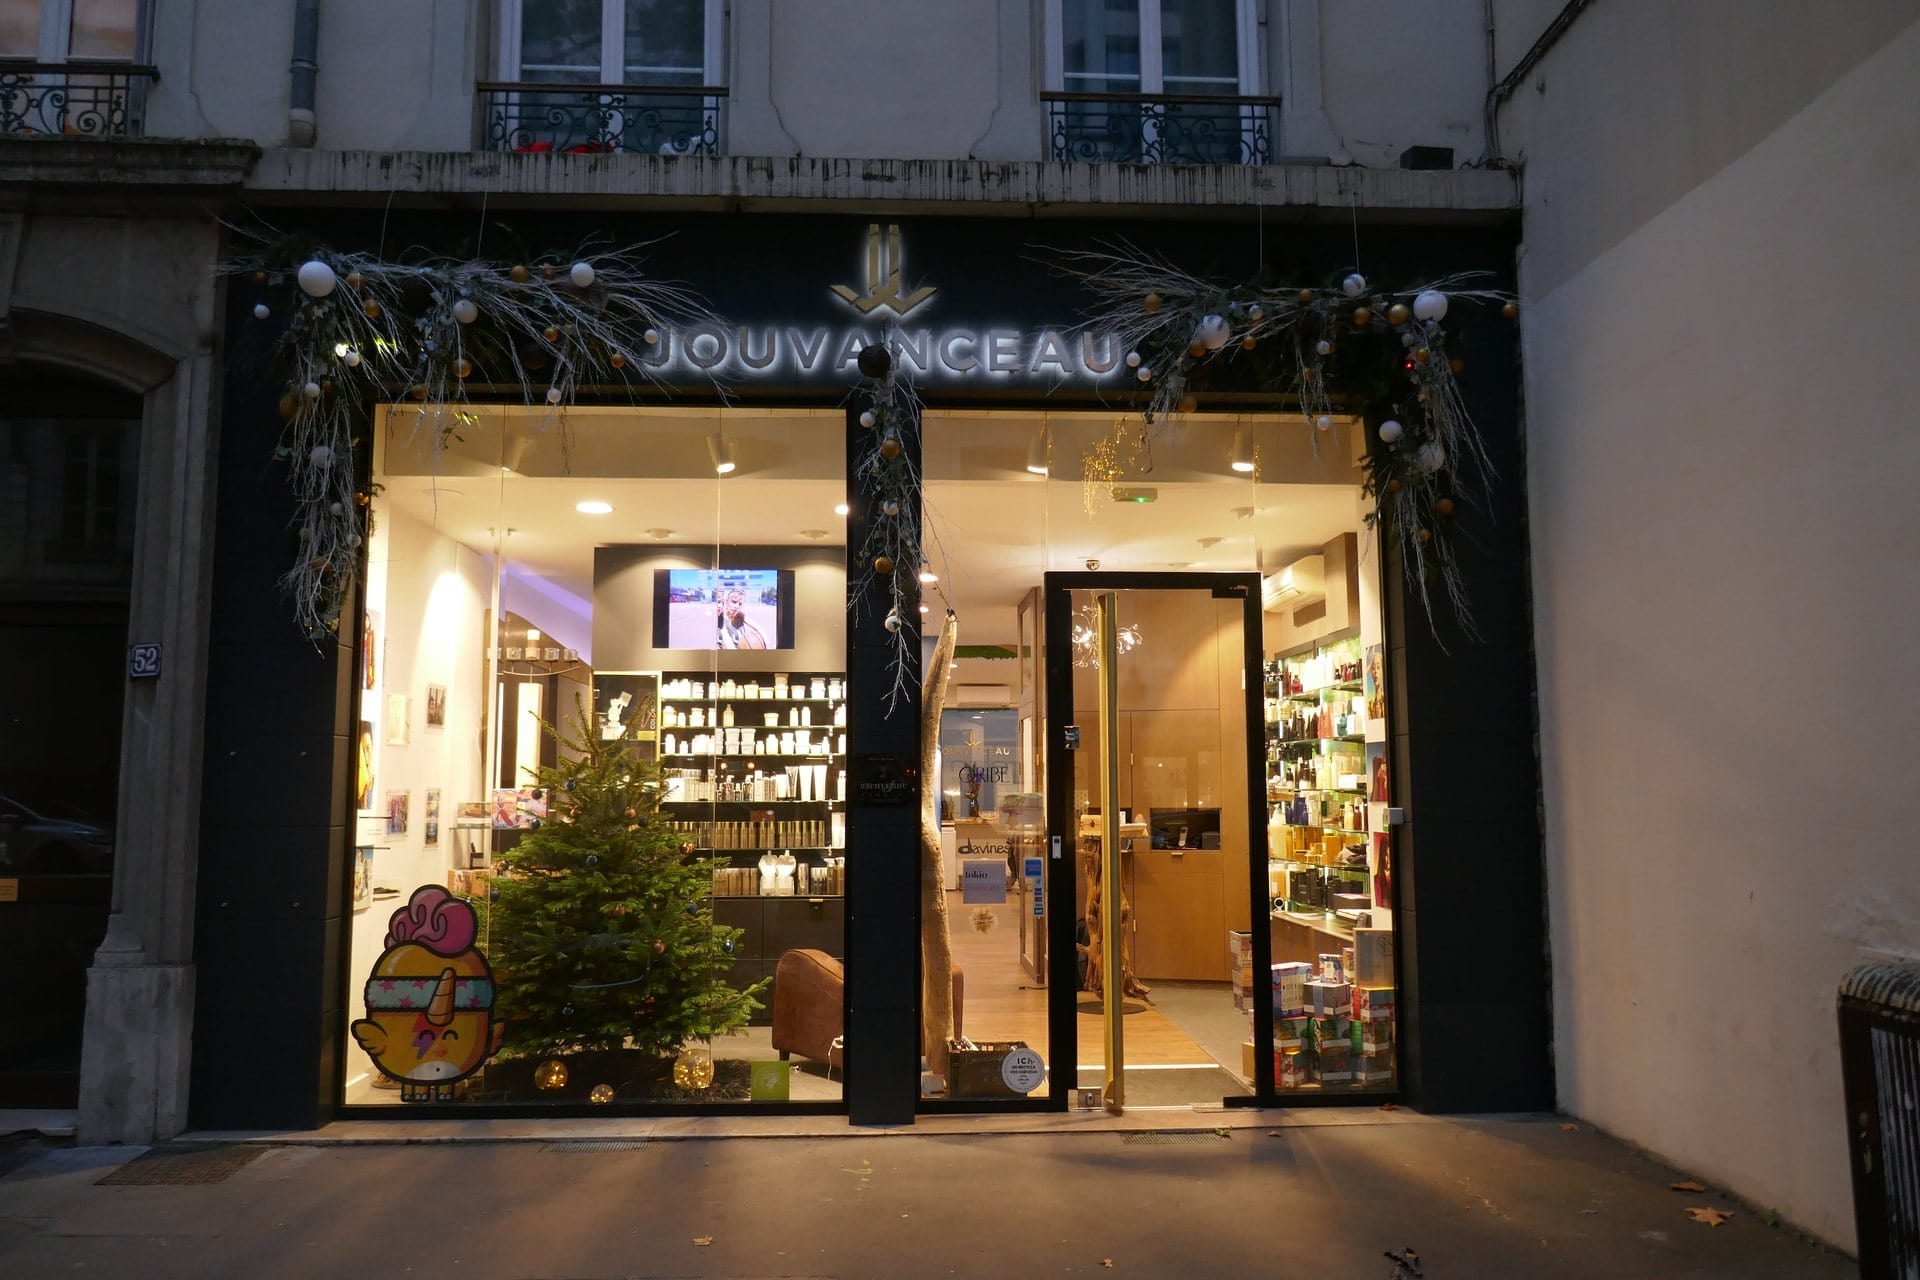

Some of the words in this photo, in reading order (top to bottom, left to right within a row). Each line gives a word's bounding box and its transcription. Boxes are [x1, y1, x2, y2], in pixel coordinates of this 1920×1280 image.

[642, 323, 1120, 374] JOUVANCEAU
[134, 647, 157, 672] 52
[959, 766, 1010, 783] ORIBE
[958, 837, 1009, 855] davines
